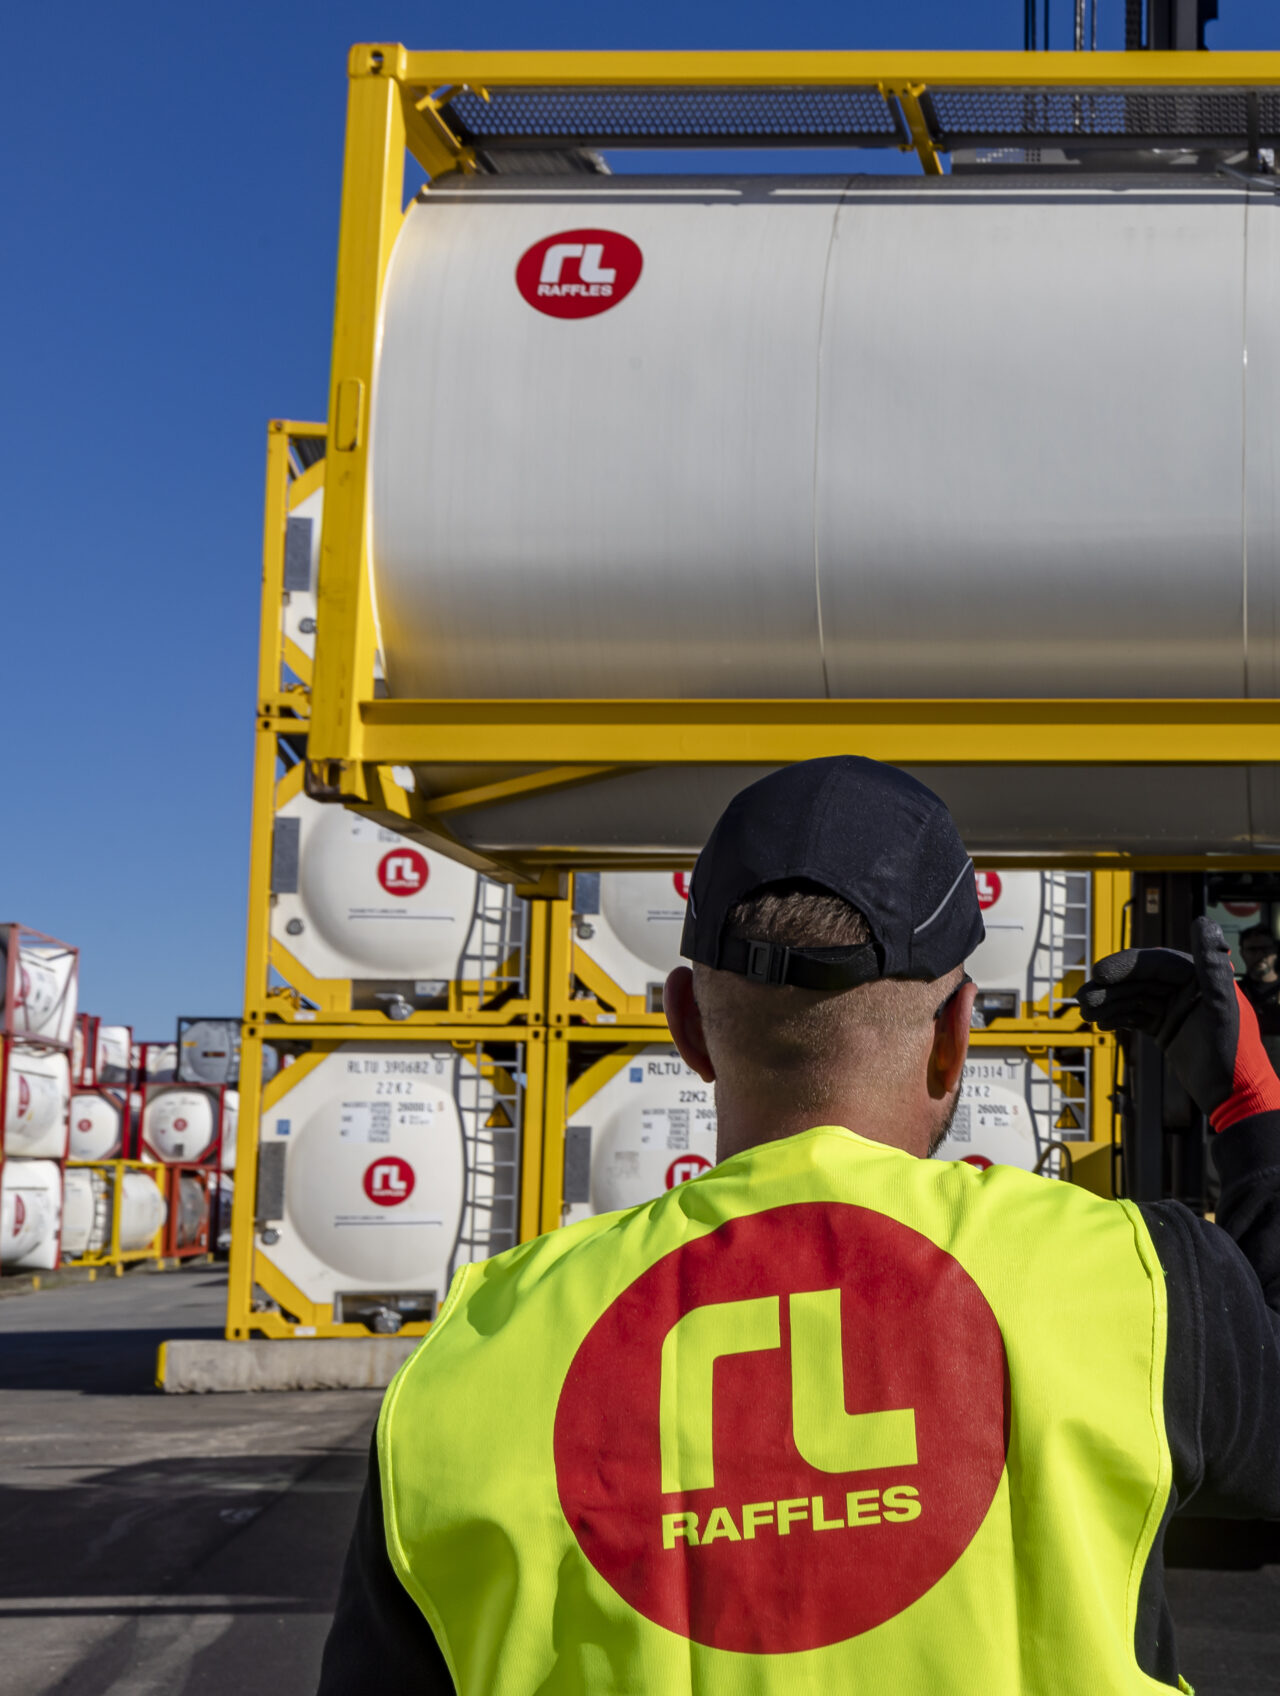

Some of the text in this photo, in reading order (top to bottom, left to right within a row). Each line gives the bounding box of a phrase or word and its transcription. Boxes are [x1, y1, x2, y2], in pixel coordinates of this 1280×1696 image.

[537, 284, 613, 297] RAFFLES
[347, 1060, 379, 1074] RLTU
[647, 1062, 681, 1075] RLTU
[679, 1090, 707, 1102] 22K2
[662, 1485, 922, 1550] RAFFLES
